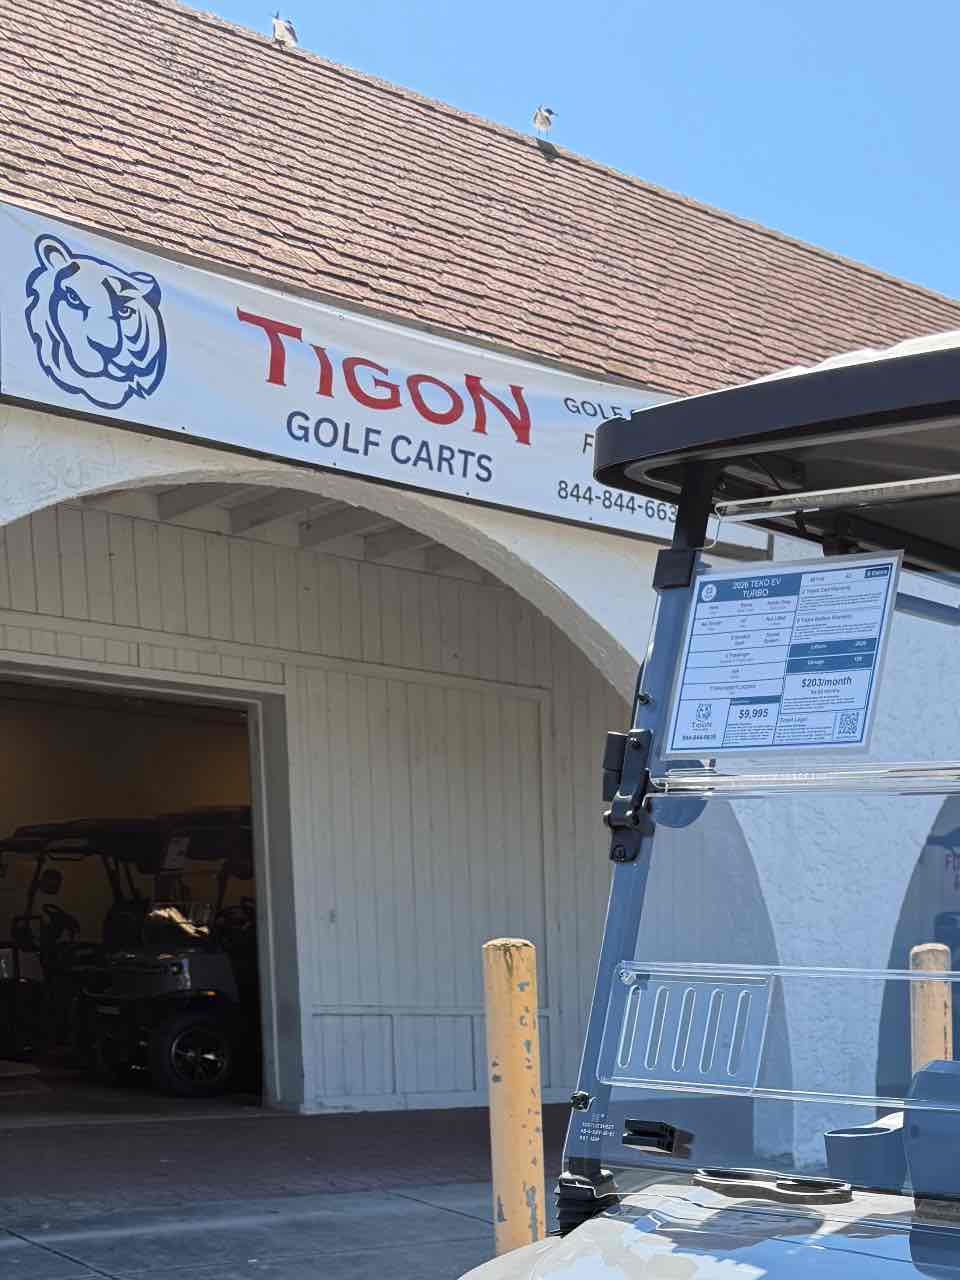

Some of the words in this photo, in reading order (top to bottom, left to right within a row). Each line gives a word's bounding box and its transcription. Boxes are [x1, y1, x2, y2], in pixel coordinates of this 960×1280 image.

[236, 306, 531, 445] TIGON
[286, 411, 381, 456] GOLF
[391, 435, 492, 482] CARTS
[558, 480, 678, 523] 844-844-663
[743, 589, 769, 598] TURBO
[801, 676, 853, 688] $203/month
[738, 708, 769, 720] $9,995
